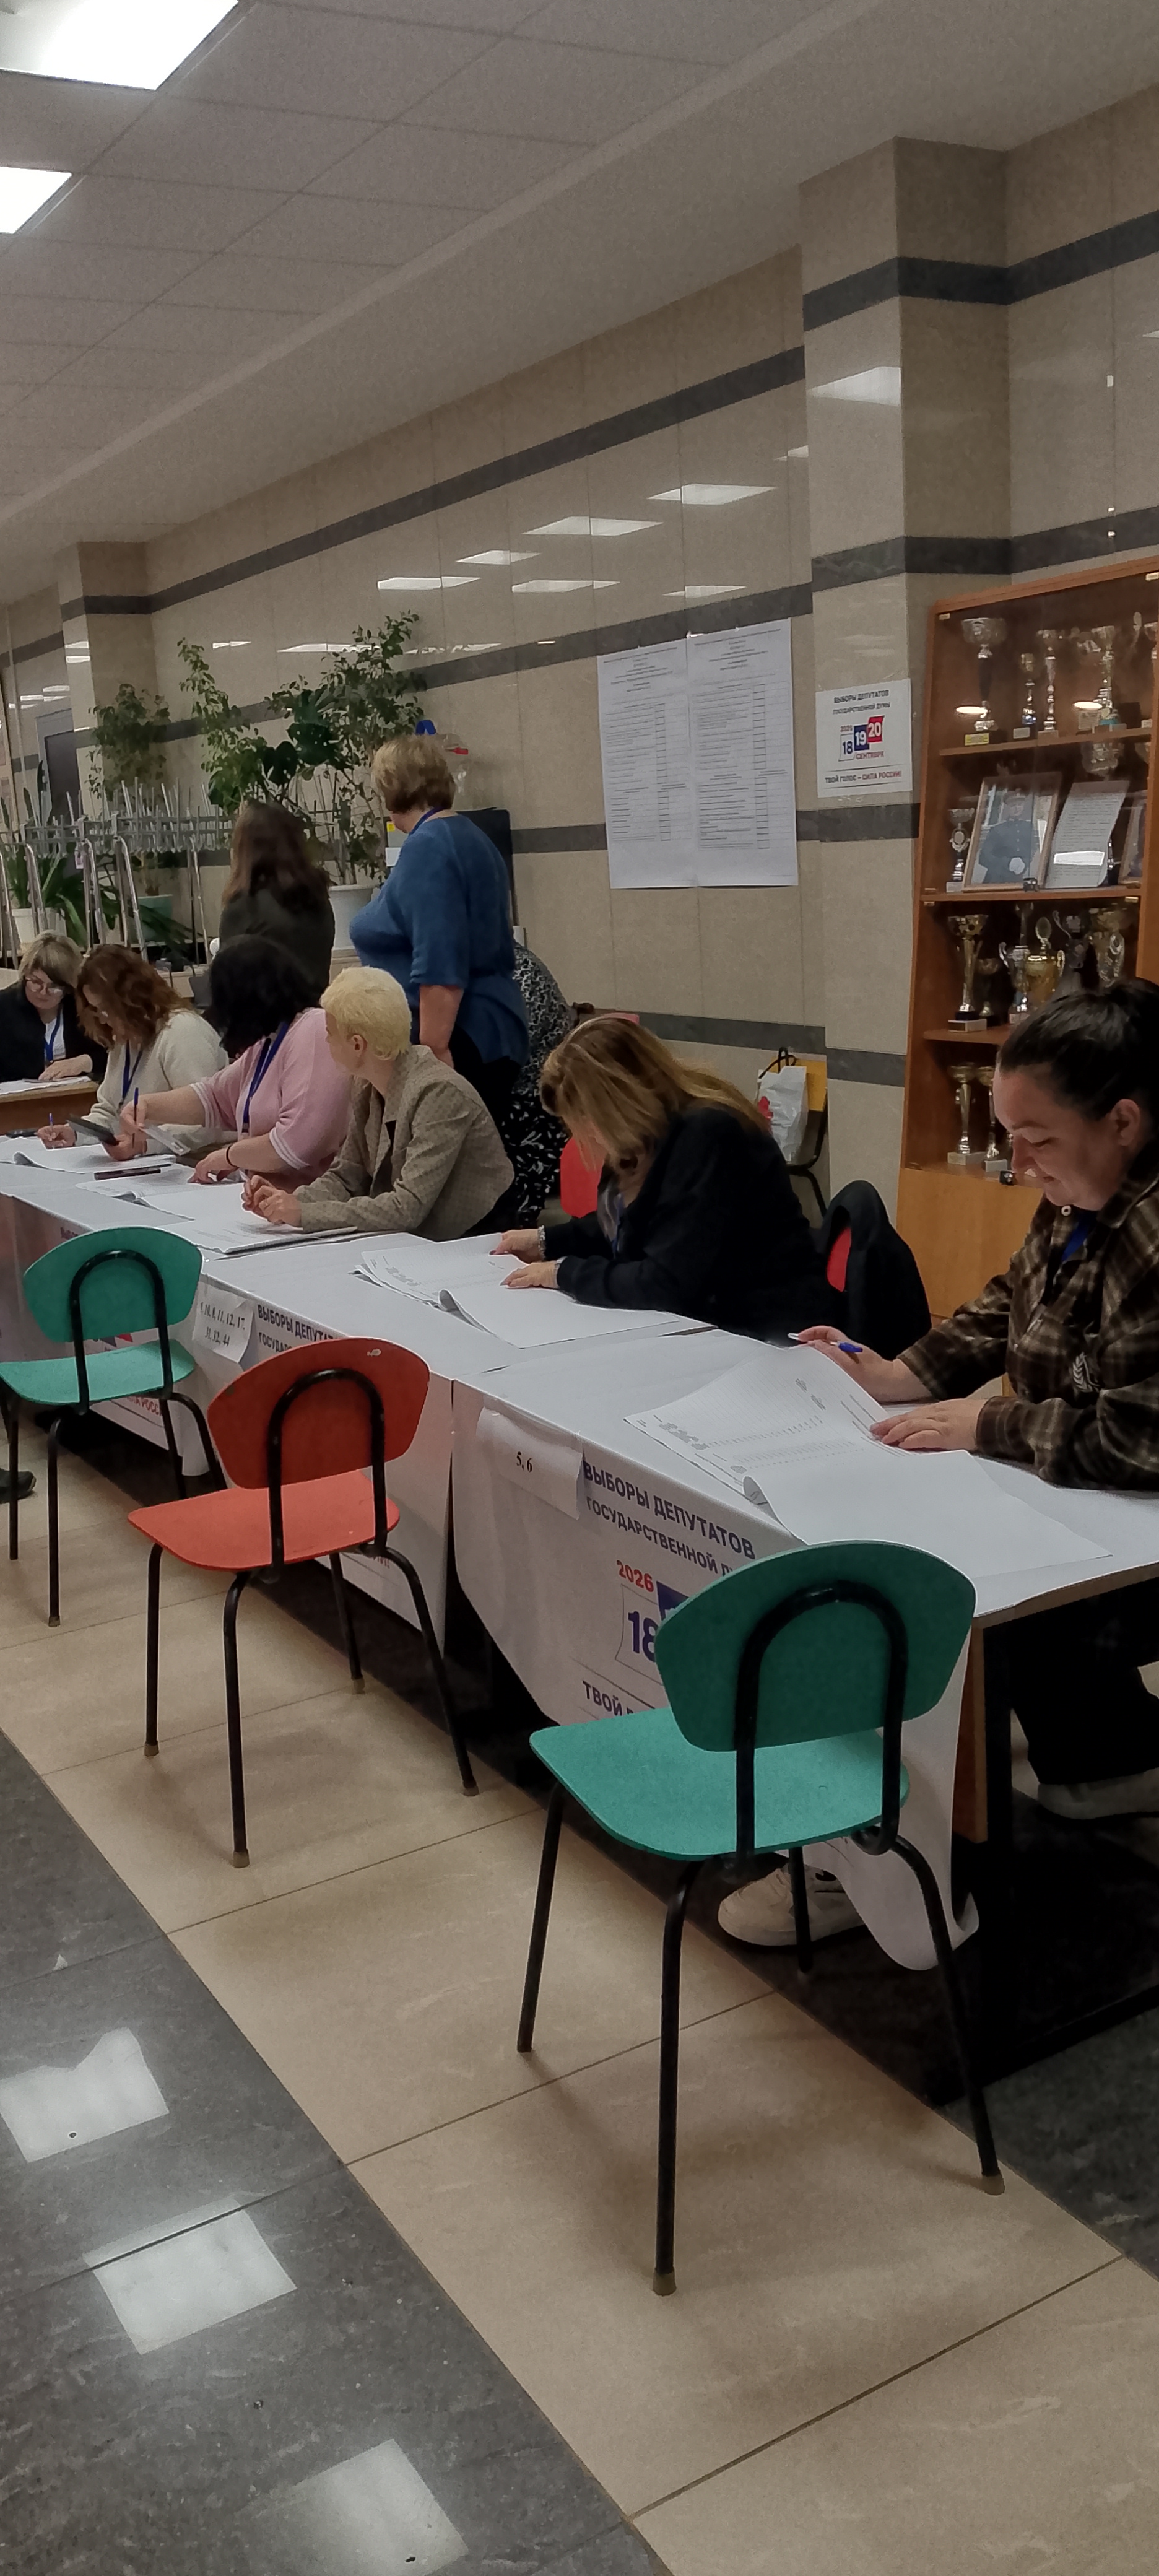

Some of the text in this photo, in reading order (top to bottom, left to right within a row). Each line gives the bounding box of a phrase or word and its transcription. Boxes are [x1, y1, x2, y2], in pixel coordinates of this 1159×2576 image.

[833, 690, 889, 703] ВЫБОРЫ ДЕПУТАТОВ
[843, 722, 882, 754] 18 19 20
[825, 775, 838, 783] ТВОЙ
[226, 1313, 235, 1326] 12,
[258, 1304, 293, 1333] ВЫБОРЫ
[516, 1451, 532, 1473] 5, 6
[583, 1460, 755, 1560] ВЫБОРЫ ДЕПУТАТОВ
[586, 1496, 718, 1574] ГОСУДАРСТВЕННОЙ
[617, 1560, 654, 1593] 2026
[628, 1611, 659, 1663] 18
[583, 1680, 622, 1716] ТВОЙ
